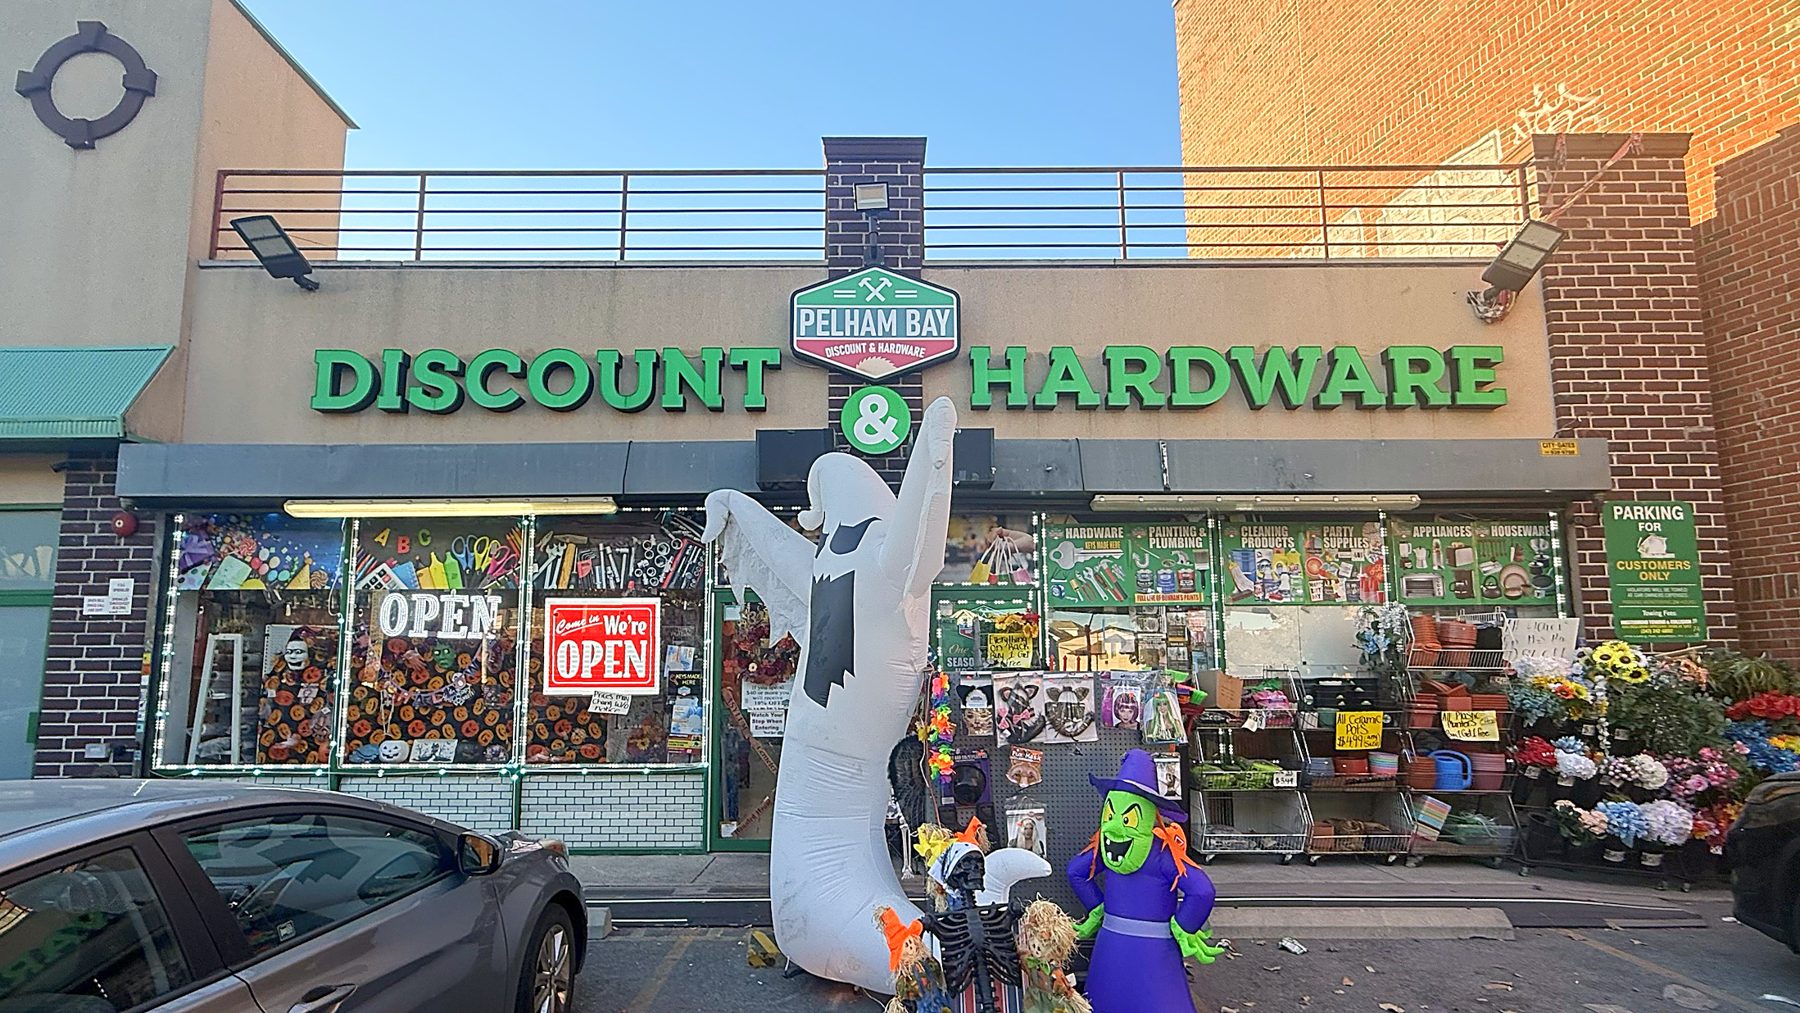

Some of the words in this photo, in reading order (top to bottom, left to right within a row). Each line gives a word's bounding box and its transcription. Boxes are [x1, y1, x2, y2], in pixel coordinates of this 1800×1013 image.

[800, 309, 897, 337] PELHAM
[906, 309, 951, 337] BAY
[825, 342, 867, 358] DISCOUNT
[868, 344, 876, 354] &
[877, 342, 926, 358] HARDWARE
[311, 348, 781, 414] DISCOUNT
[968, 345, 1509, 411] HARDWARE
[853, 394, 899, 445] &
[1613, 505, 1684, 520] PARKING
[1149, 526, 1197, 537] PAINTING
[1199, 527, 1207, 537] &
[1241, 525, 1289, 537] CLEANING
[1323, 526, 1354, 537] PARTY
[1413, 526, 1472, 537] APPLIANCES
[1638, 522, 1661, 531] FOR
[1065, 527, 1124, 539] HARDWARE
[1084, 541, 1096, 549] KEYS
[1097, 541, 1109, 549] MADE
[1149, 537, 1203, 548] PLUMBING
[1241, 537, 1295, 548] PRODUCTS
[1323, 537, 1370, 549] SUPPLIES
[1616, 561, 1691, 570] CUSTOMERS
[1639, 571, 1670, 580] ONLY
[380, 592, 502, 639] OPEN
[555, 619, 587, 635] Come
[589, 614, 600, 624] in
[603, 615, 647, 635] We're
[948, 644, 969, 654] One
[556, 640, 648, 679] OPEN
[947, 657, 975, 667] SEASO
[1337, 713, 1346, 724] All
